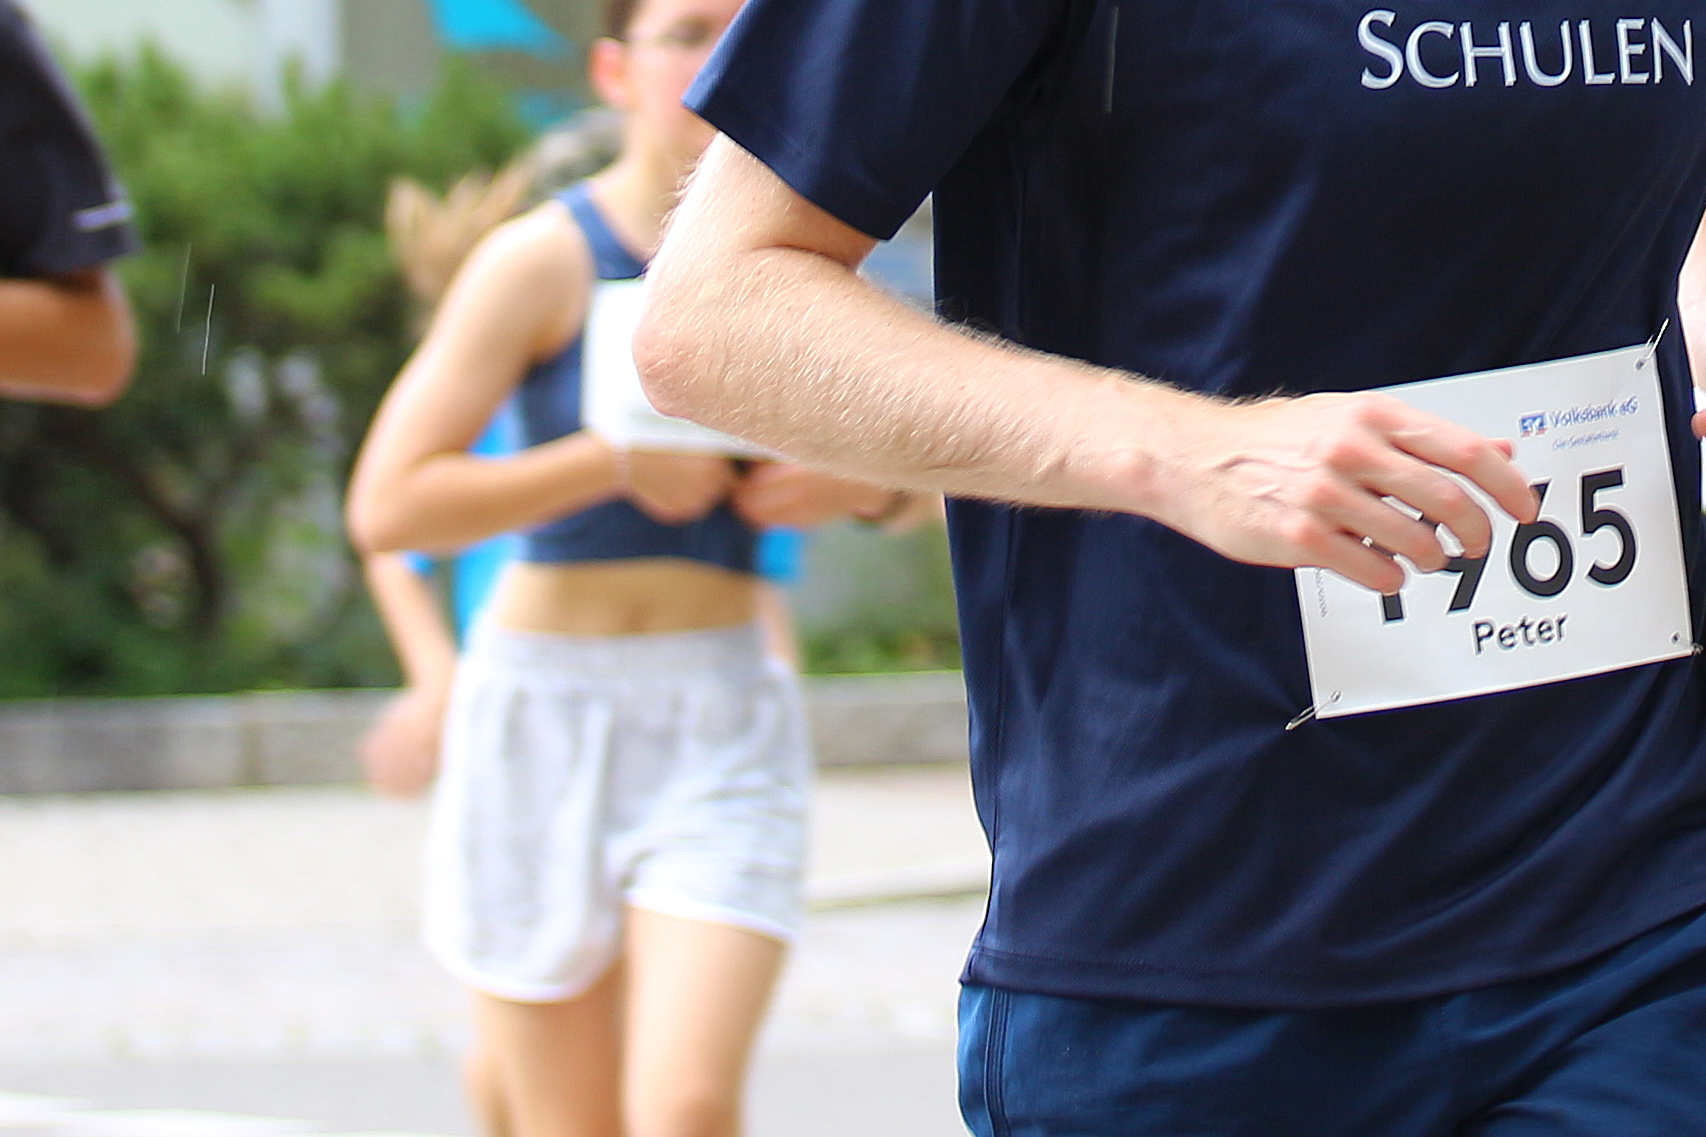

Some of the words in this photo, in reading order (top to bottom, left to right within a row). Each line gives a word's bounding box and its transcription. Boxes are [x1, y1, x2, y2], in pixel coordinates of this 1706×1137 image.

[1357, 9, 1694, 90] SCHULEN
[1549, 401, 1617, 428] Volksbank
[1382, 469, 1636, 621] 65
[1473, 614, 1568, 655] Peter
